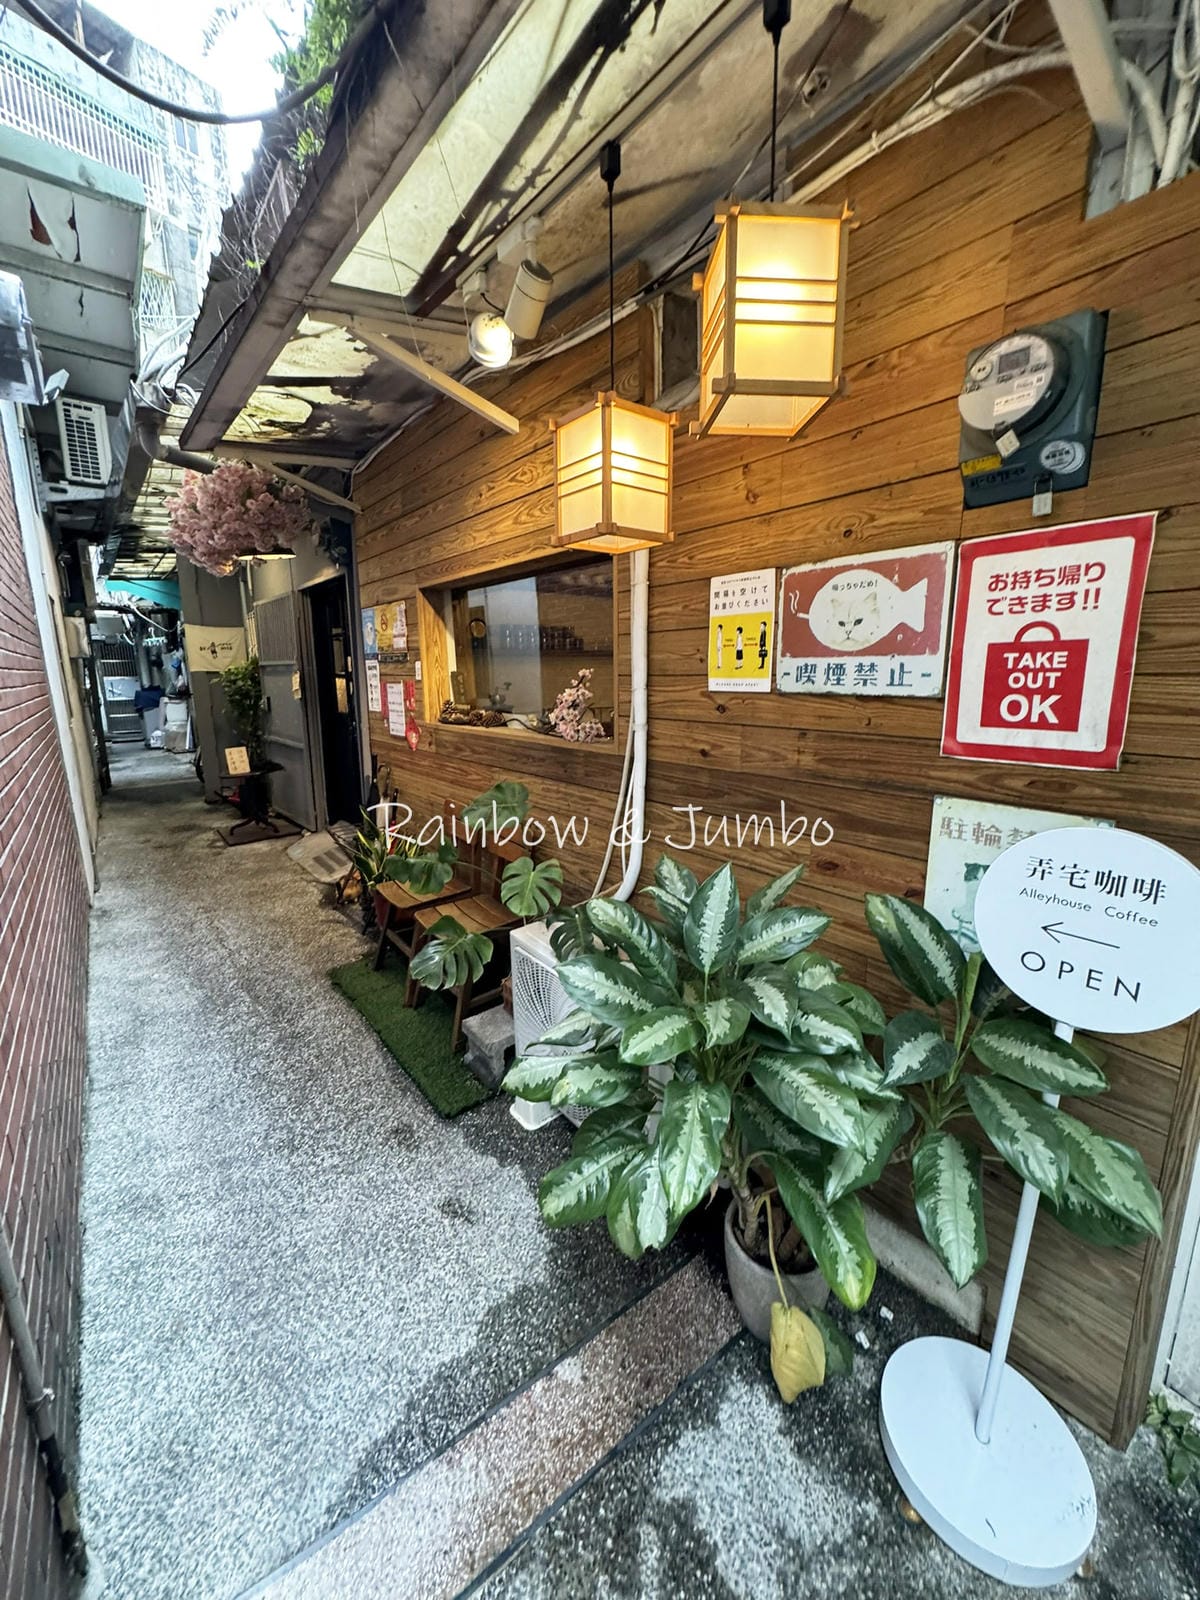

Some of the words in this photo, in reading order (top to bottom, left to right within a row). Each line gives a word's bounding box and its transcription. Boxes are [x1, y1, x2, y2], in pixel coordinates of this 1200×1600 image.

[987, 561, 1106, 592] お持ち帰り
[1003, 651, 1068, 669] TAKE
[1007, 671, 1062, 689] OUT
[999, 694, 1062, 724] OK
[1025, 855, 1167, 906] 弄宅咖啡
[1019, 887, 1092, 913] Alleyhouse
[1104, 906, 1159, 928] Coffee
[1020, 951, 1143, 1003] OPEN
